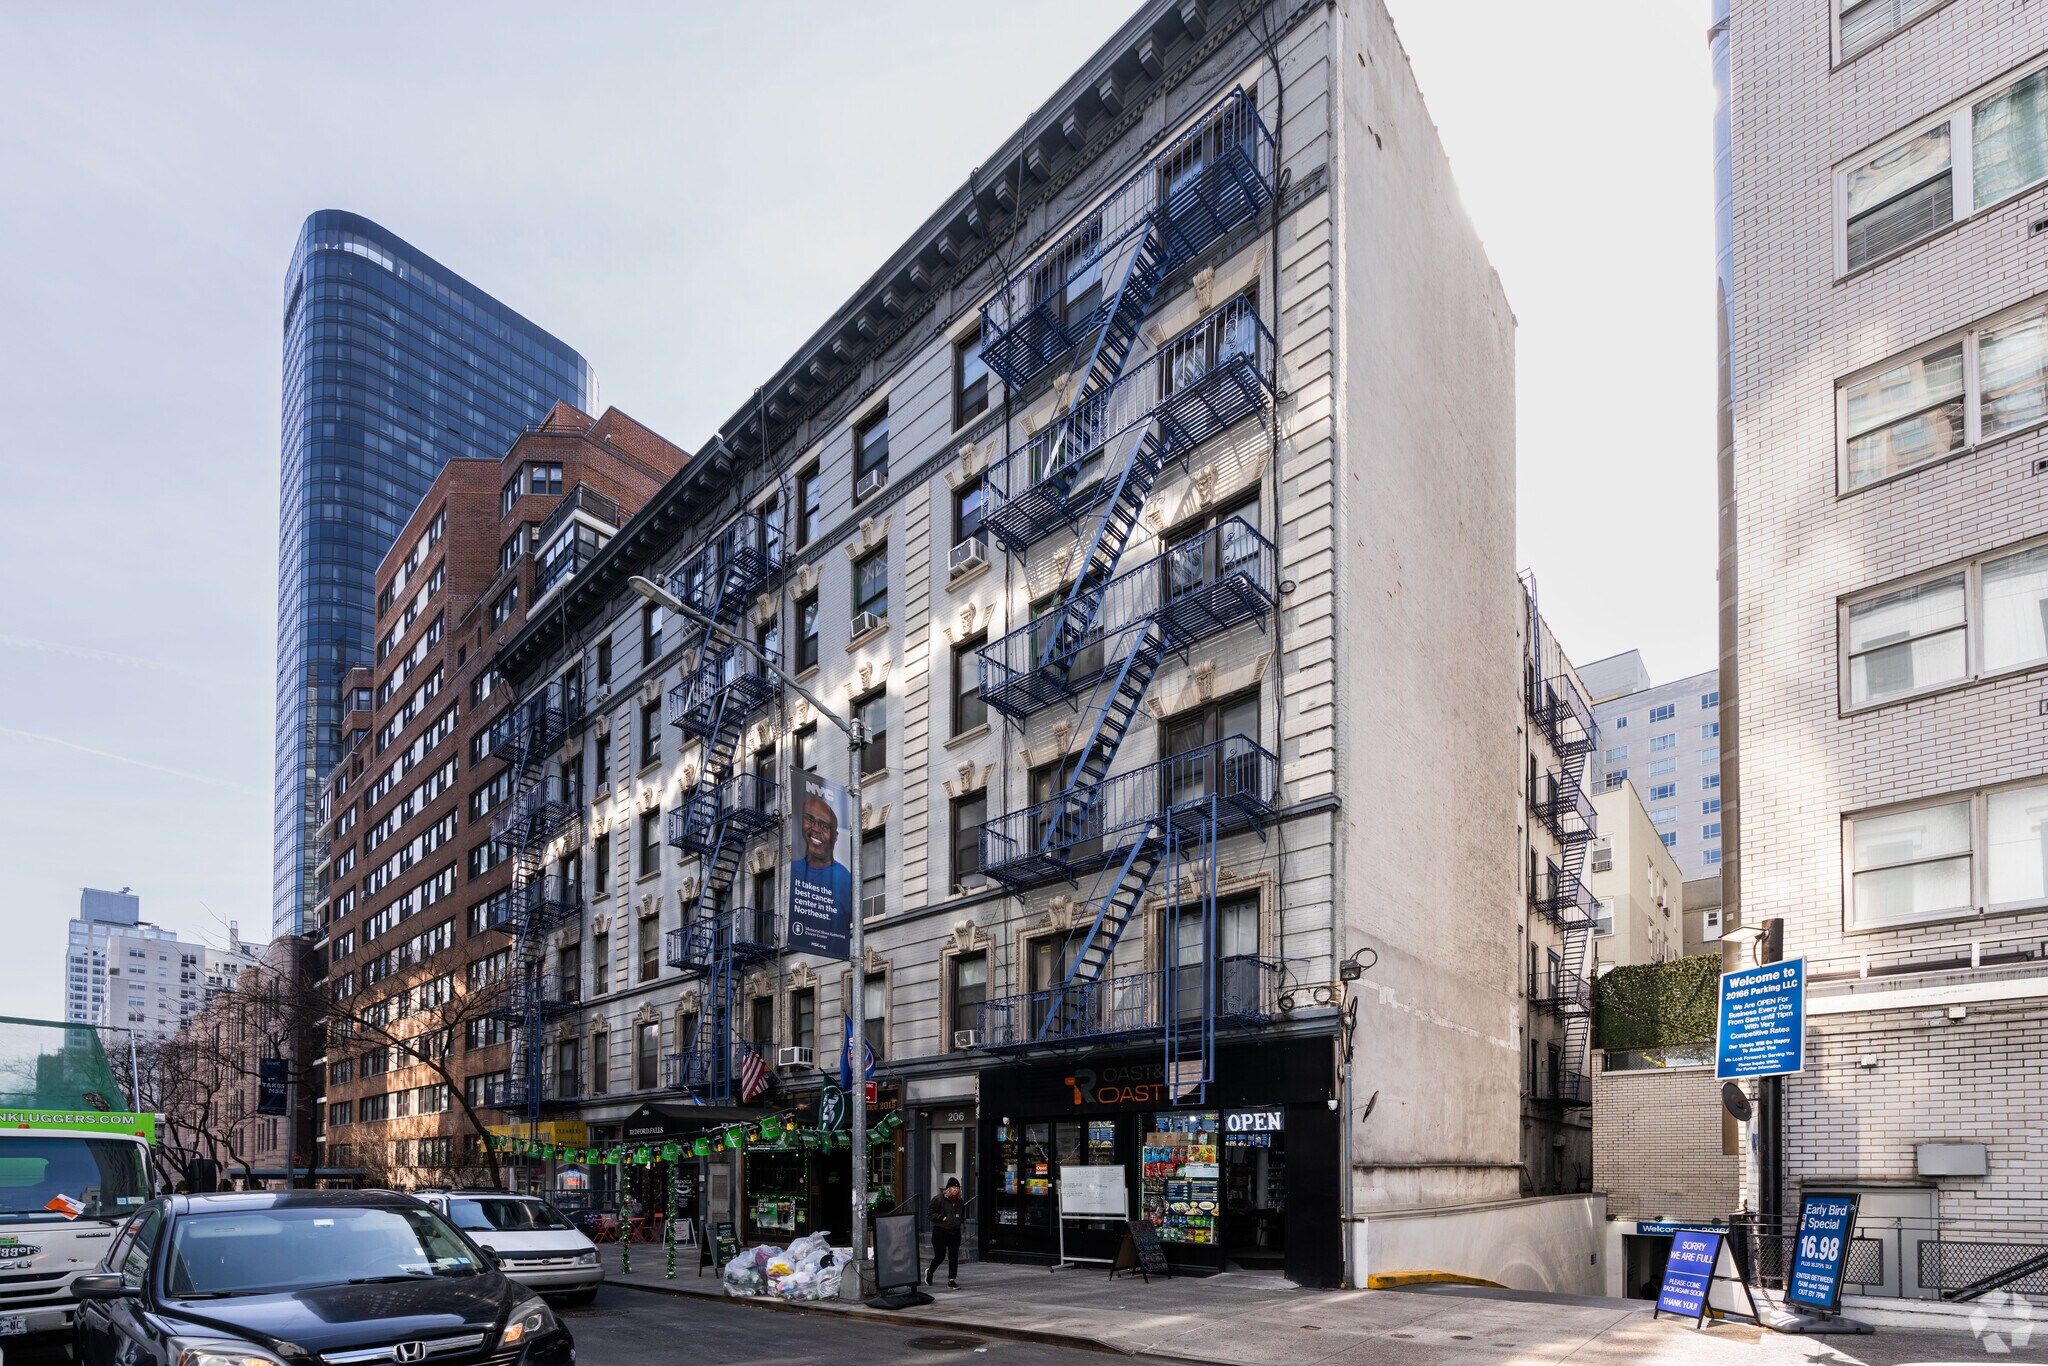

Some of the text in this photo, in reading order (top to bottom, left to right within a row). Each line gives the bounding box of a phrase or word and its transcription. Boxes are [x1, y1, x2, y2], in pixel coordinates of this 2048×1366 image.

[806, 780, 834, 802] NYC
[795, 878, 833, 896] It takes the
[795, 887, 834, 904] best cancer
[794, 898, 838, 914] center in the
[794, 904, 832, 921] Northeast.
[1730, 967, 1796, 989] Welcome to
[1726, 979, 1798, 1001] 20166 Parking LLC
[1743, 1002, 1755, 1010] Are
[1757, 998, 1776, 1007] OPEN
[1777, 996, 1789, 1004] For
[1729, 1003, 1793, 1019] Business Every Day
[1728, 1011, 1794, 1026] From 6am until 11pm
[1744, 1021, 1775, 1031] With Very
[1730, 1027, 1790, 1040] Competitive Rates
[879, 1101, 896, 1110] 2015
[948, 1113, 965, 1121] 206
[1227, 1112, 1282, 1132] OPEN
[629, 1126, 664, 1136] BEDFORD FALLS
[1805, 1203, 1848, 1217] Early Bird
[1808, 1217, 1840, 1231] Special
[1682, 1241, 1707, 1251] SORRY
[1800, 1235, 1840, 1262] 16.98
[1670, 1251, 1713, 1264] WE ARE FULL
[1669, 1278, 1702, 1289] PLEASE COME
[1796, 1271, 1834, 1284] ENTER BETWEEN
[1797, 1280, 1809, 1288] 6AM
[1662, 1284, 1705, 1298] BACK AGAIN SOON
[1797, 1288, 1826, 1300] OUT BY 7PM
[1663, 1297, 1698, 1311] THANK YOU!
